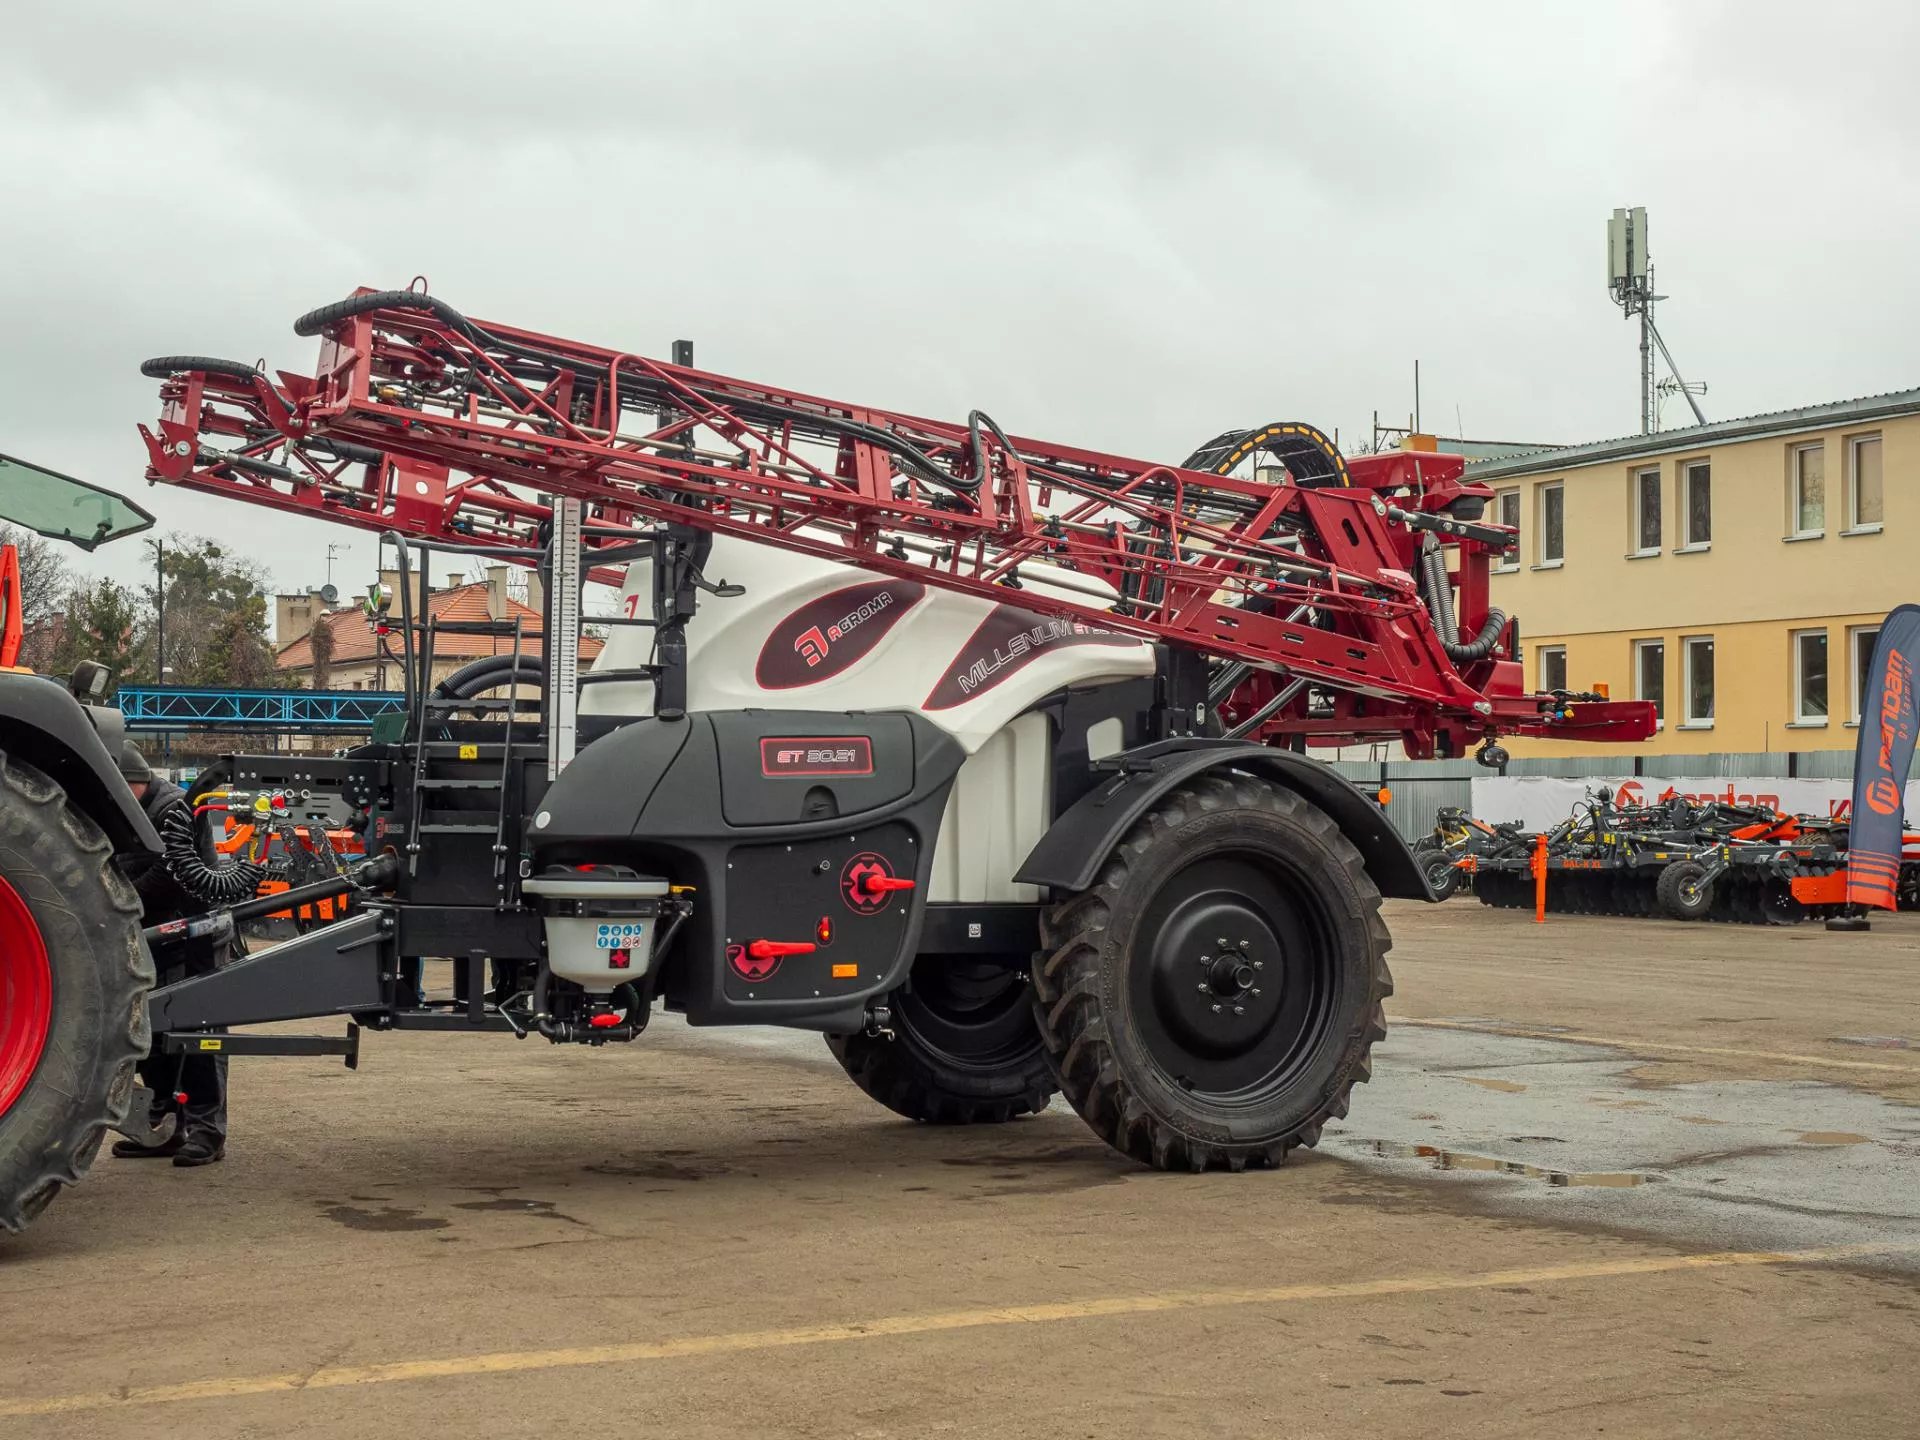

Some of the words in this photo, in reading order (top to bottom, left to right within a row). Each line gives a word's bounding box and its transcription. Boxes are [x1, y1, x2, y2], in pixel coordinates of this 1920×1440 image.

[828, 592, 894, 642] AGROMA
[958, 619, 1073, 693] MILLENIUM
[777, 750, 804, 763] ET
[807, 749, 856, 763] 30.21
